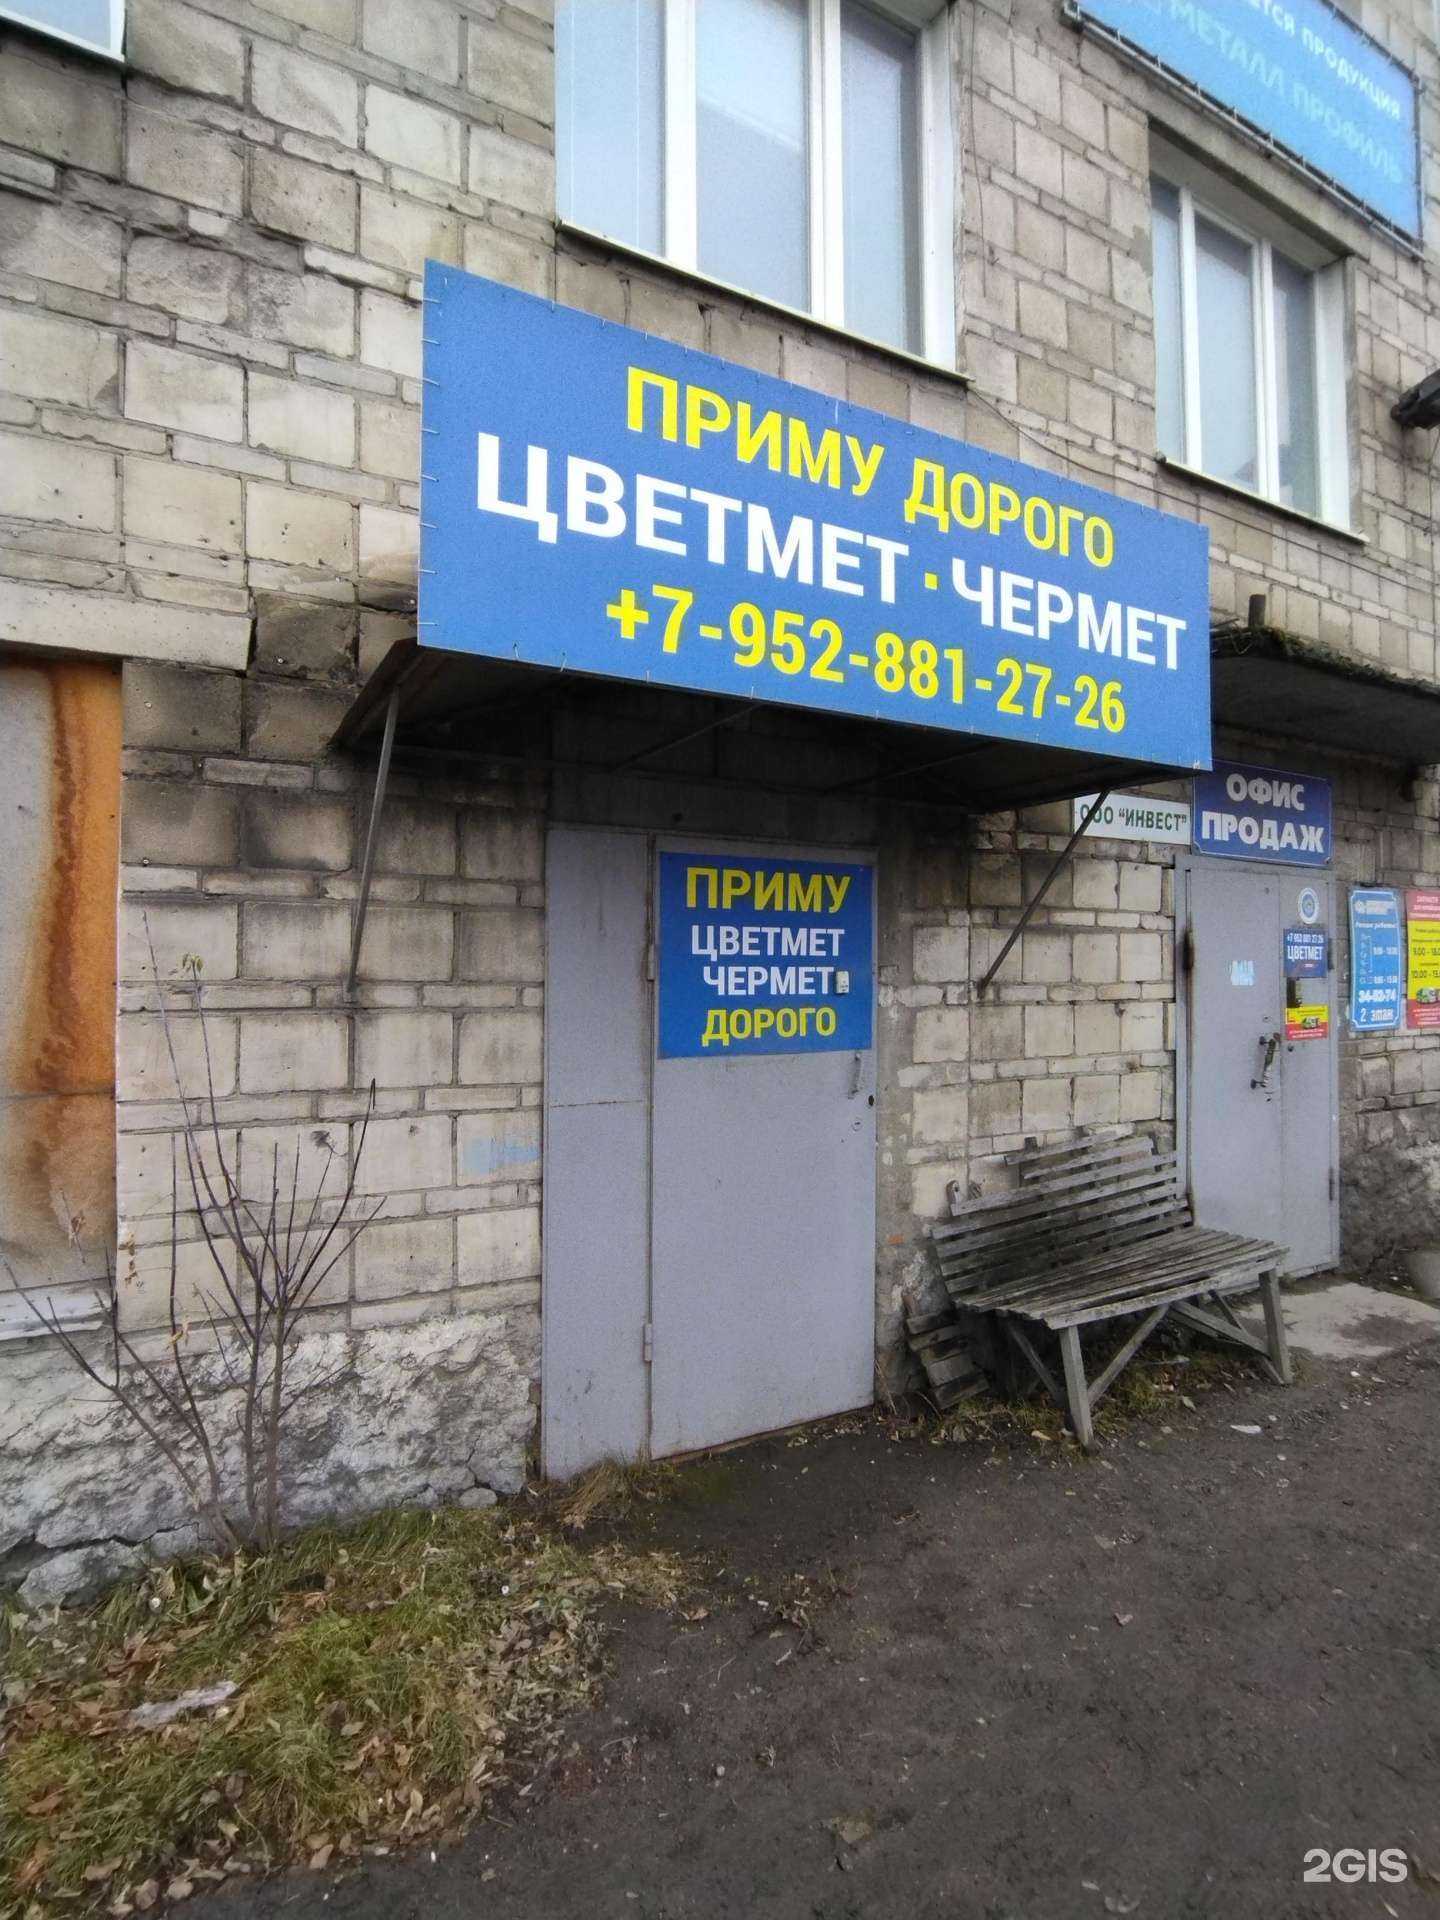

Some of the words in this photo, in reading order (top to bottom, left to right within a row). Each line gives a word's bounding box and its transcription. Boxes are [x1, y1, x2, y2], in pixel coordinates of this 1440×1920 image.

[1249, 0, 1295, 35] ТСЯ
[1302, 24, 1400, 120] ПРОДУКЦИЯ
[626, 366, 885, 496] ПРИМУ
[904, 459, 1114, 568] ДОРОГО
[476, 432, 909, 604] ЦВЕТМЕТ
[952, 566, 1187, 671] ЧЕРМЕТ
[606, 584, 1126, 733] +7-952-881-27-26
[1226, 773, 1305, 811] ОФИС
[1201, 810, 1324, 854] ПРОДАЖ
[686, 867, 850, 913] ПРИМУ
[691, 925, 845, 961] ЦВЕТМЕТ
[1287, 945, 1323, 962] ЦВЕТМЕТ
[703, 966, 834, 995] ЧЕРМЕТ
[701, 1007, 837, 1047] ДОРОГО
